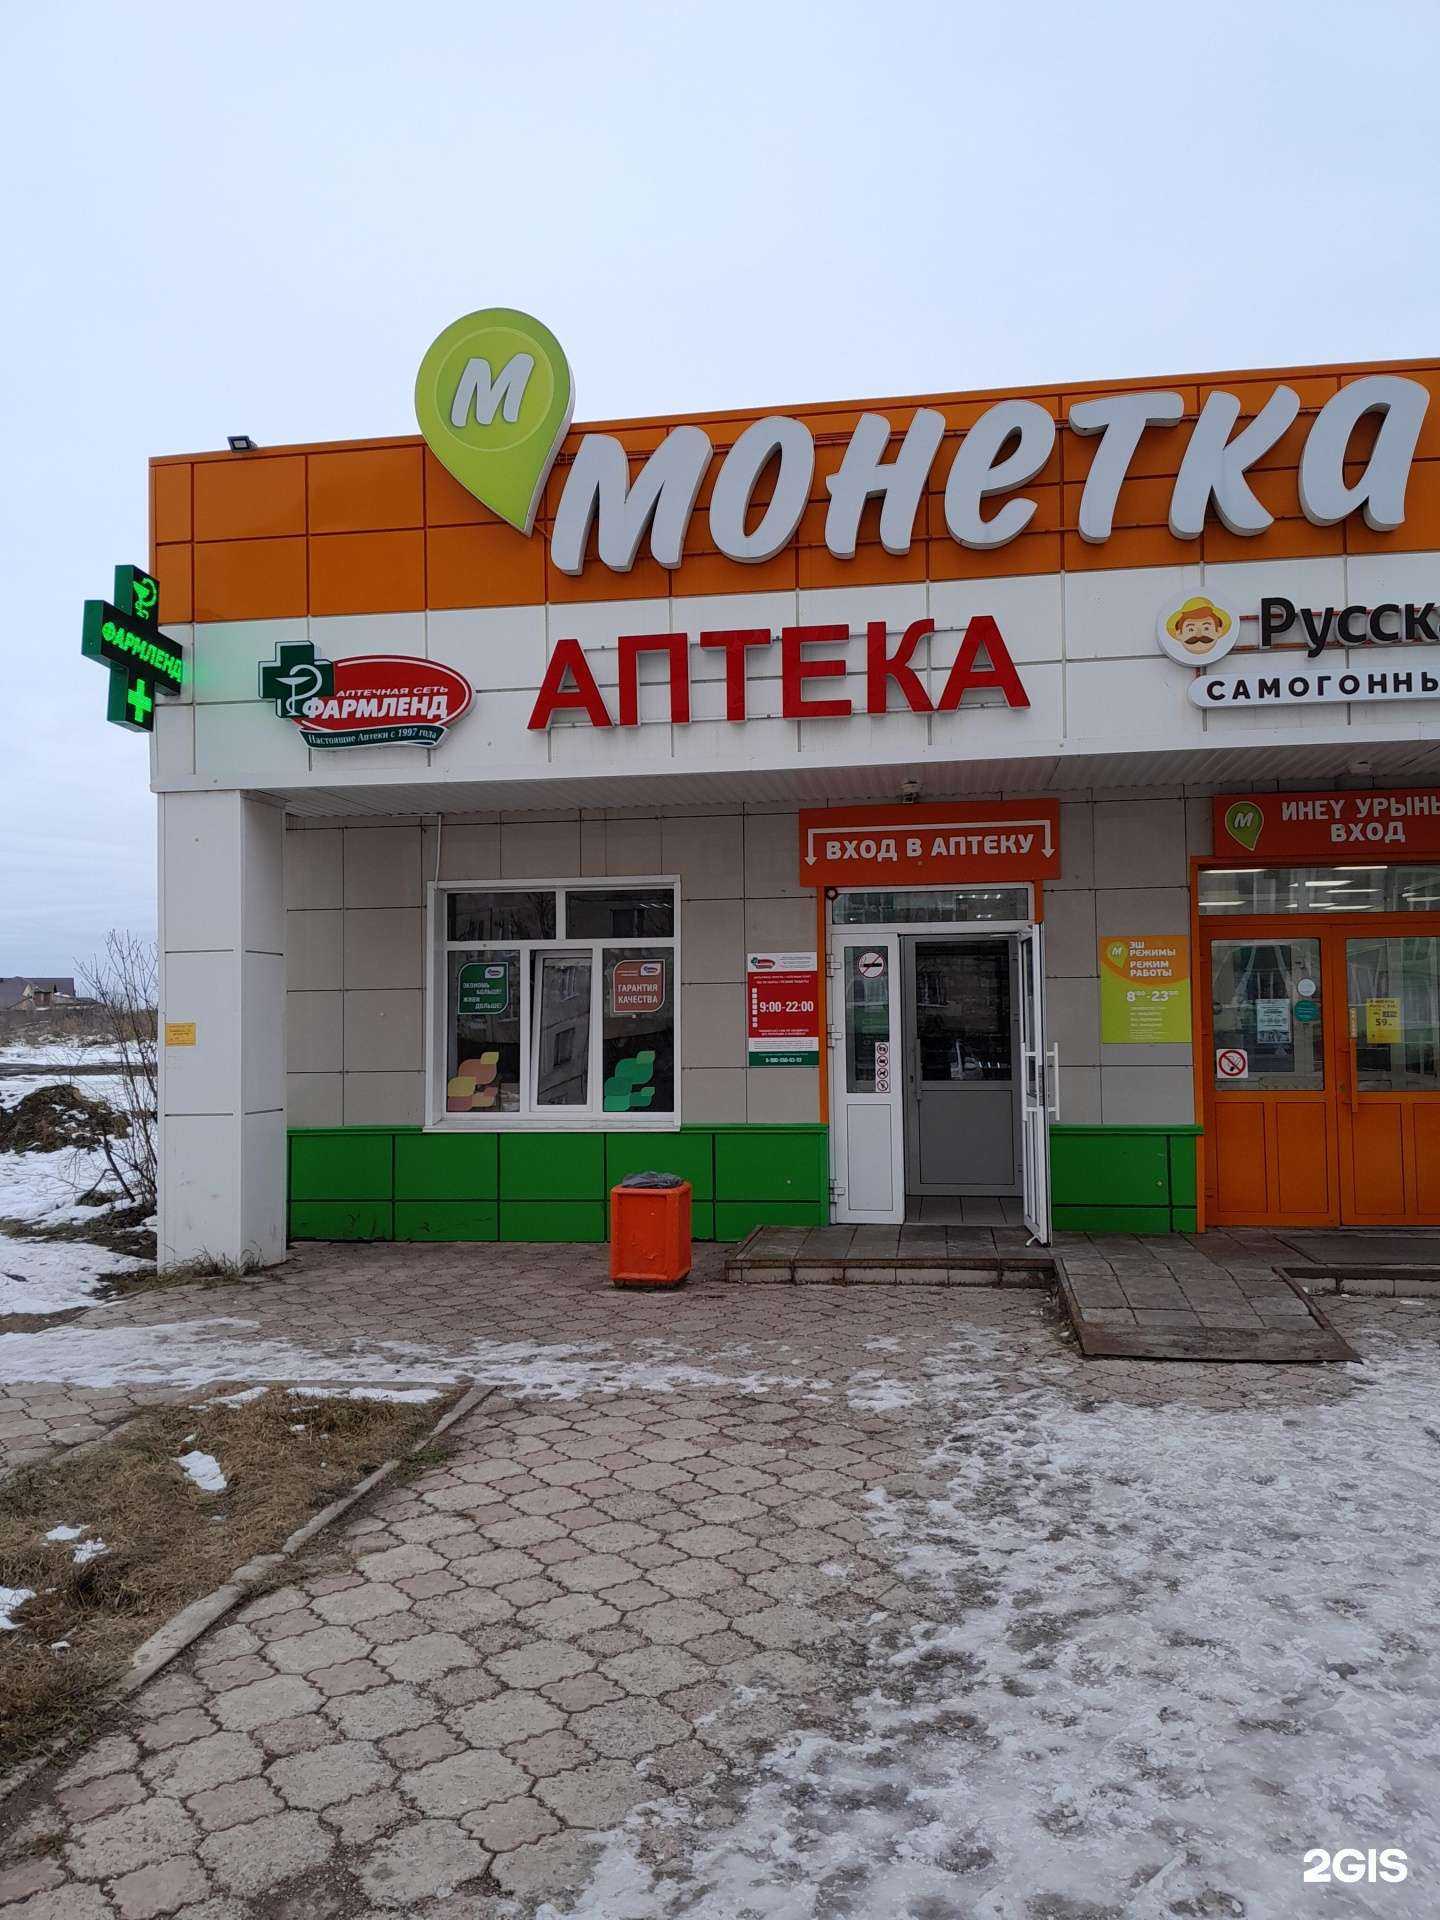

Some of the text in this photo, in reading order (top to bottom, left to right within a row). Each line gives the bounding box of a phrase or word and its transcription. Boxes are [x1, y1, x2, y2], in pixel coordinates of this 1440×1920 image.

[1261, 597, 1440, 658] Русск
[102, 621, 183, 683] ФАРМЛЕНД
[527, 615, 1031, 731] АПТЕКА
[336, 686, 449, 697] АПТЕЧНАЯ СЕТЬ
[302, 695, 448, 719] ФАРМЛЕНД
[308, 733, 356, 745] Настоящие
[358, 731, 389, 742] Аптеки
[398, 728, 417, 737] 1997
[418, 729, 437, 739] года
[1331, 821, 1406, 843] ВХОД
[826, 834, 1034, 862] ВХОД В АПТЕКУ
[1130, 949, 1176, 957] РЕЖИМЫ
[1130, 960, 1169, 968] РЕЖИМ
[1130, 969, 1173, 977] РАБОТЫ
[617, 983, 658, 993] ГАРАНТИЯ
[618, 994, 659, 1004] КАЧЕСТВА
[760, 1000, 814, 1013] 9:00-22:00
